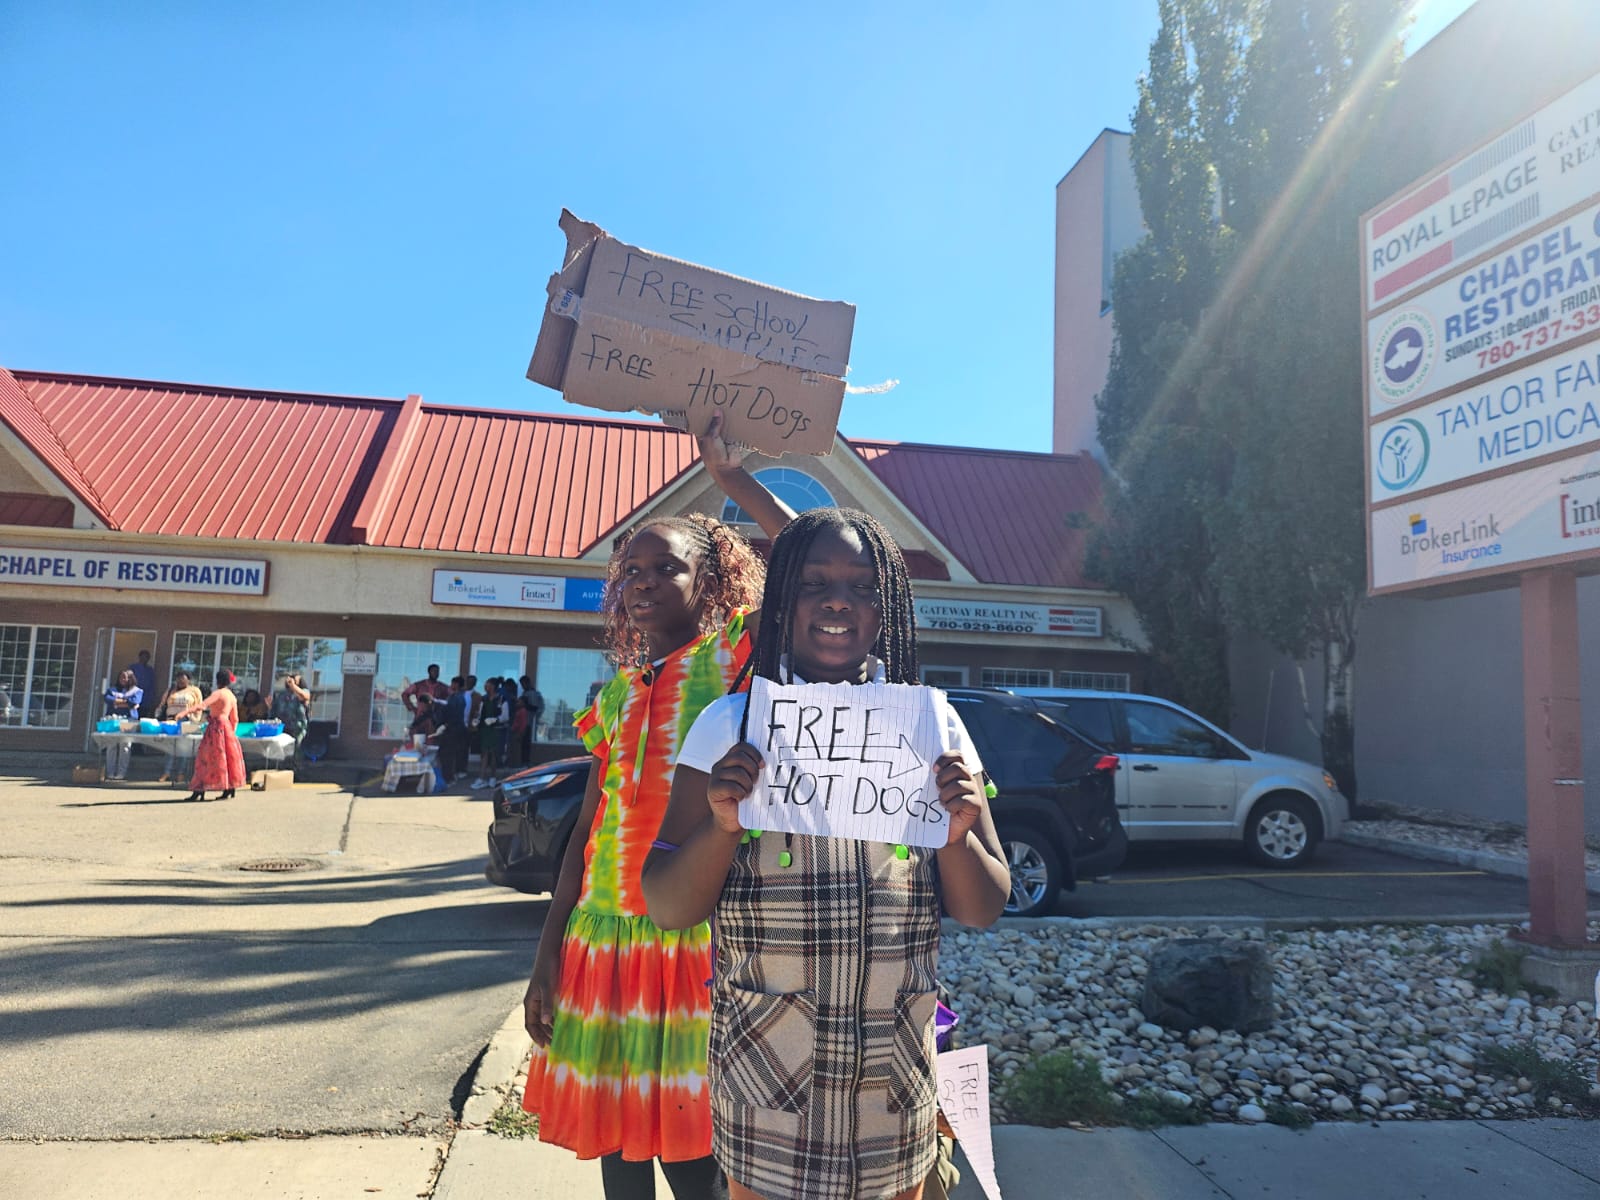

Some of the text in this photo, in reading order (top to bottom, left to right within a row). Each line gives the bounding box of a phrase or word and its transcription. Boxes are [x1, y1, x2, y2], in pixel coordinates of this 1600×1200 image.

[1372, 216, 1443, 272] ROYAL
[1459, 226, 1582, 303] CHAPEL
[608, 253, 818, 347] FREE SCHOOL
[688, 367, 750, 409] HOT
[1437, 354, 1600, 436] TAYLOR FA
[1478, 401, 1600, 464] MEDICA
[1401, 512, 1501, 556] BrokerLink
[1442, 542, 1502, 564] Insurance
[0, 555, 261, 587] CHAPEL OF RESTORATION
[920, 605, 970, 617] GATEWAY
[975, 608, 1016, 620] REALTY
[929, 620, 1033, 633] 780-929-8600
[768, 699, 885, 763] FREE
[768, 764, 844, 811] HOT
[957, 1062, 980, 1121] FREE
